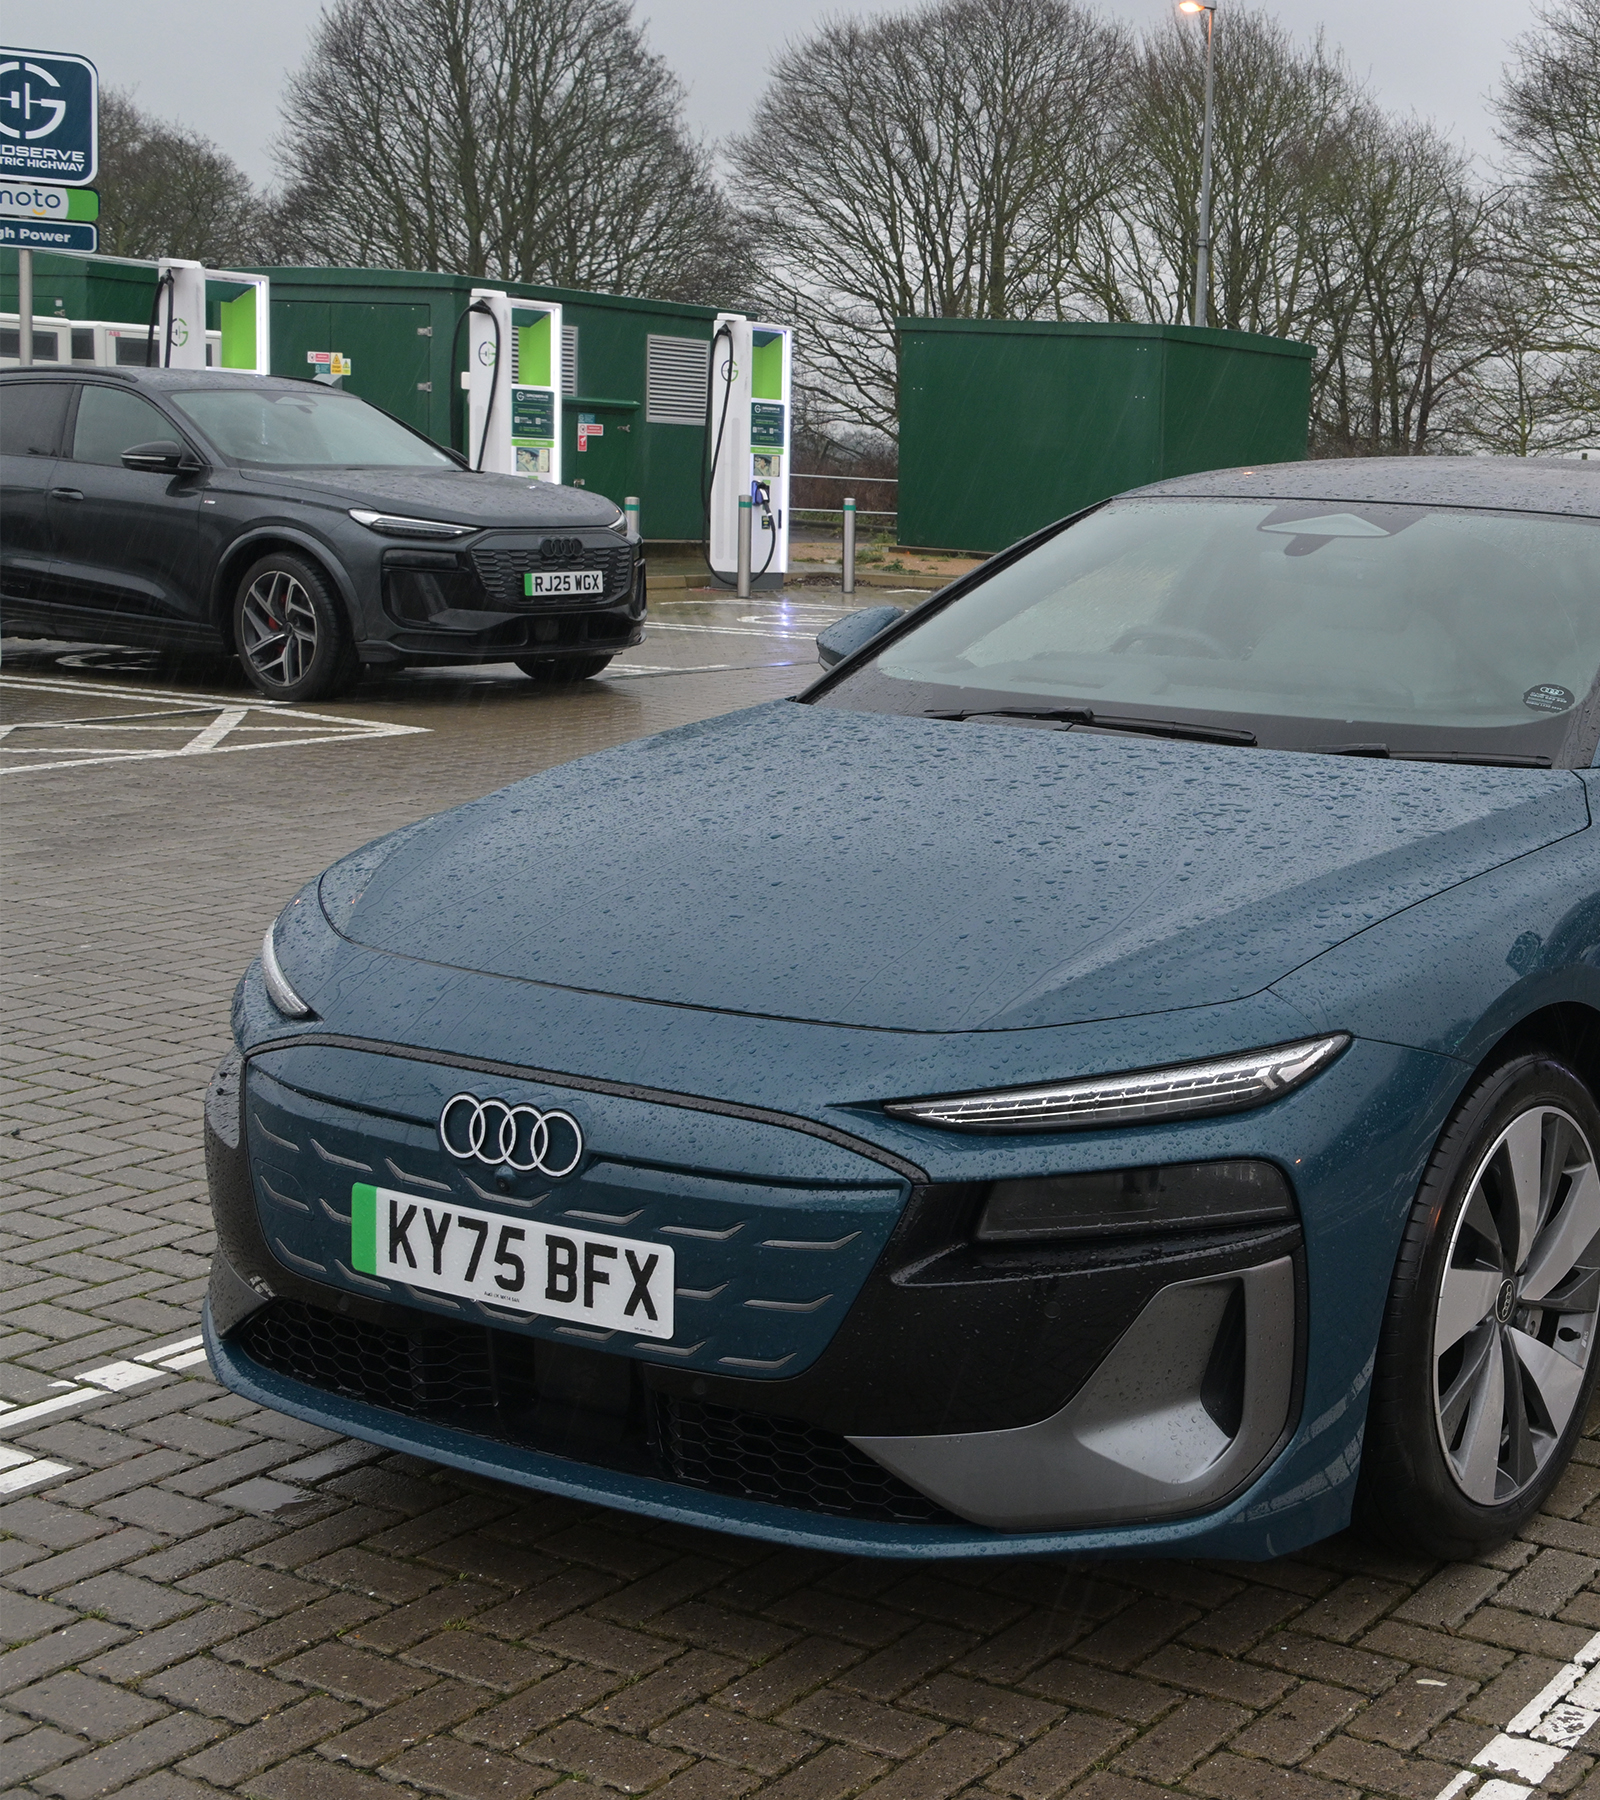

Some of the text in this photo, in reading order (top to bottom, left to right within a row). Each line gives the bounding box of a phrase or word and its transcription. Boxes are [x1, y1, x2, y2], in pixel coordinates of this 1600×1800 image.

[0, 144, 85, 162] DSERVE
[27, 159, 84, 172] HIGHWAY
[20, 228, 71, 243] Power
[534, 574, 600, 592] RJ25 WGX
[388, 1199, 660, 1322] KY75 BFX
